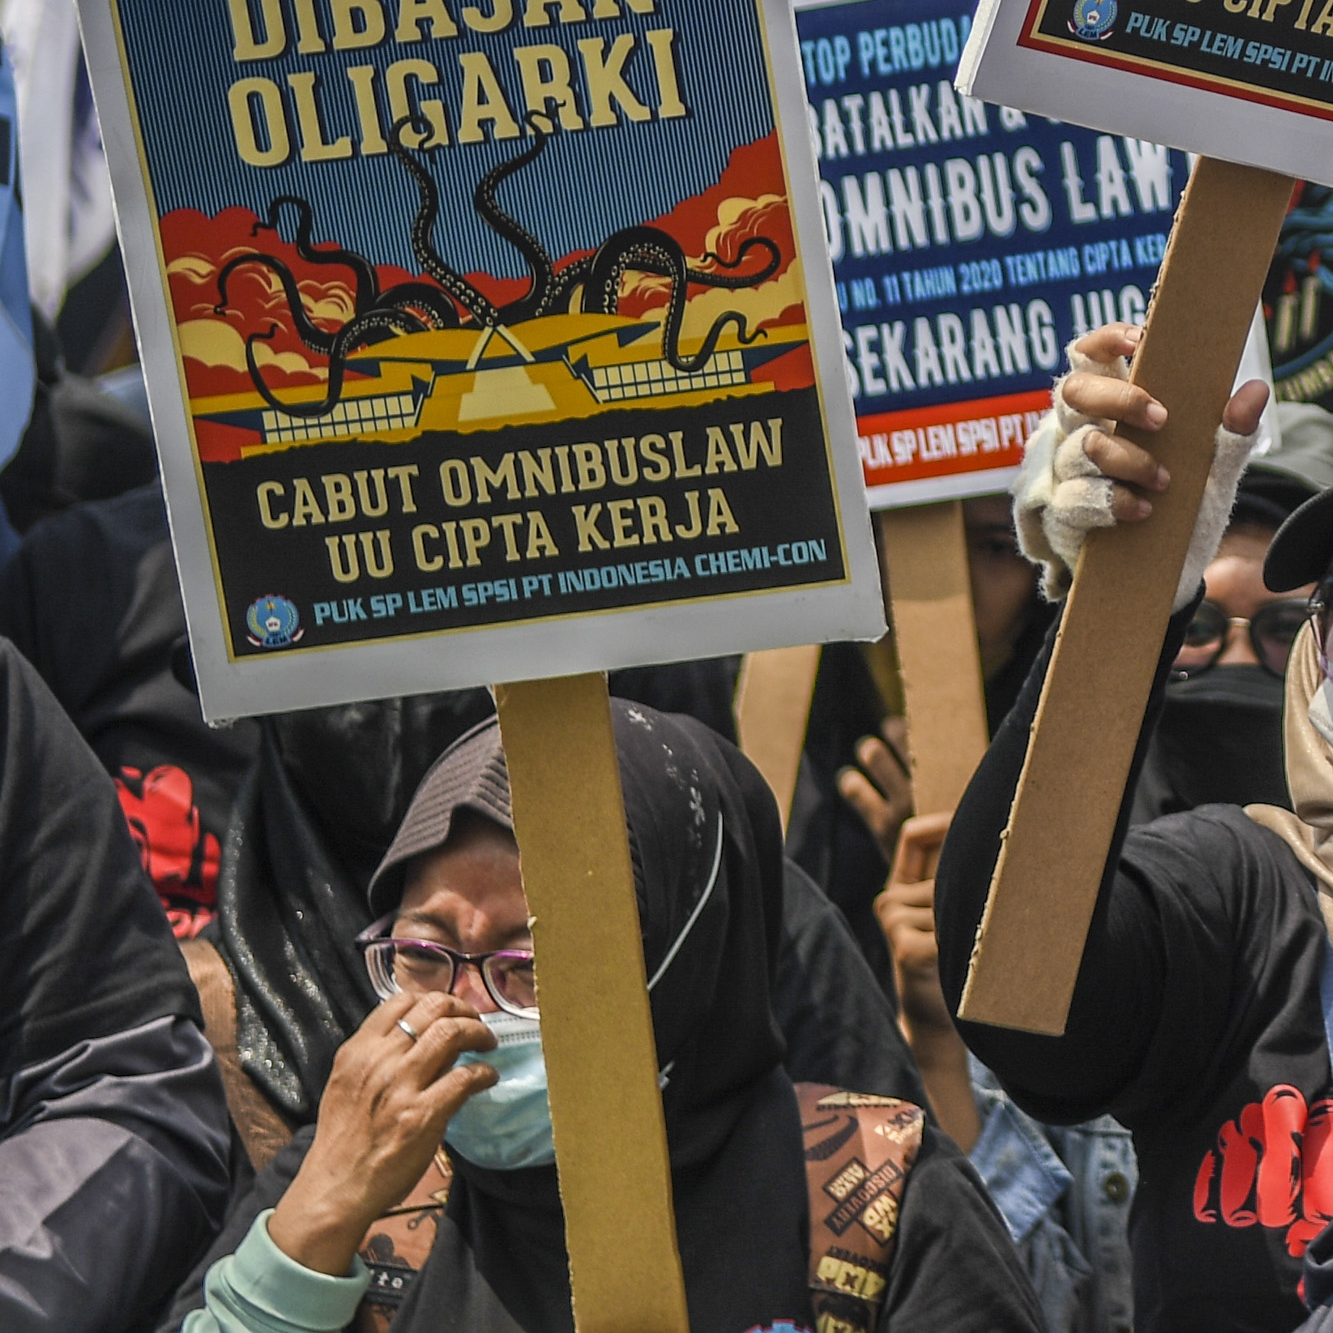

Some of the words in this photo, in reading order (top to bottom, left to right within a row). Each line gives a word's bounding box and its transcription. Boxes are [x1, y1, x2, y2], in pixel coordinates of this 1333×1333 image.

[1125, 11, 1170, 42] PUK
[1170, 23, 1200, 48] SP
[1200, 30, 1244, 61] LEM
[1243, 40, 1290, 72] SPSI
[1291, 52, 1318, 76] PT
[229, 28, 691, 169] OLIGARKI
[1060, 134, 1174, 225] LAW
[902, 266, 957, 301] TAHUN
[960, 258, 1003, 293] 2020
[1006, 246, 1081, 286] TENTANG
[1083, 239, 1133, 275] CIPTA
[257, 464, 420, 529] CABUT
[440, 418, 784, 507] OMNIBUSLAW
[325, 528, 395, 583] UU
[412, 510, 559, 572] CIPTA
[571, 488, 740, 552] KERJA
[314, 596, 368, 625] PUK
[371, 594, 402, 618] SP
[408, 588, 457, 614] LEM
[463, 581, 518, 607] SPSI
[524, 574, 552, 599] PT
[560, 561, 691, 593] INDONESIA
[695, 539, 827, 577] CHEMI-CON
